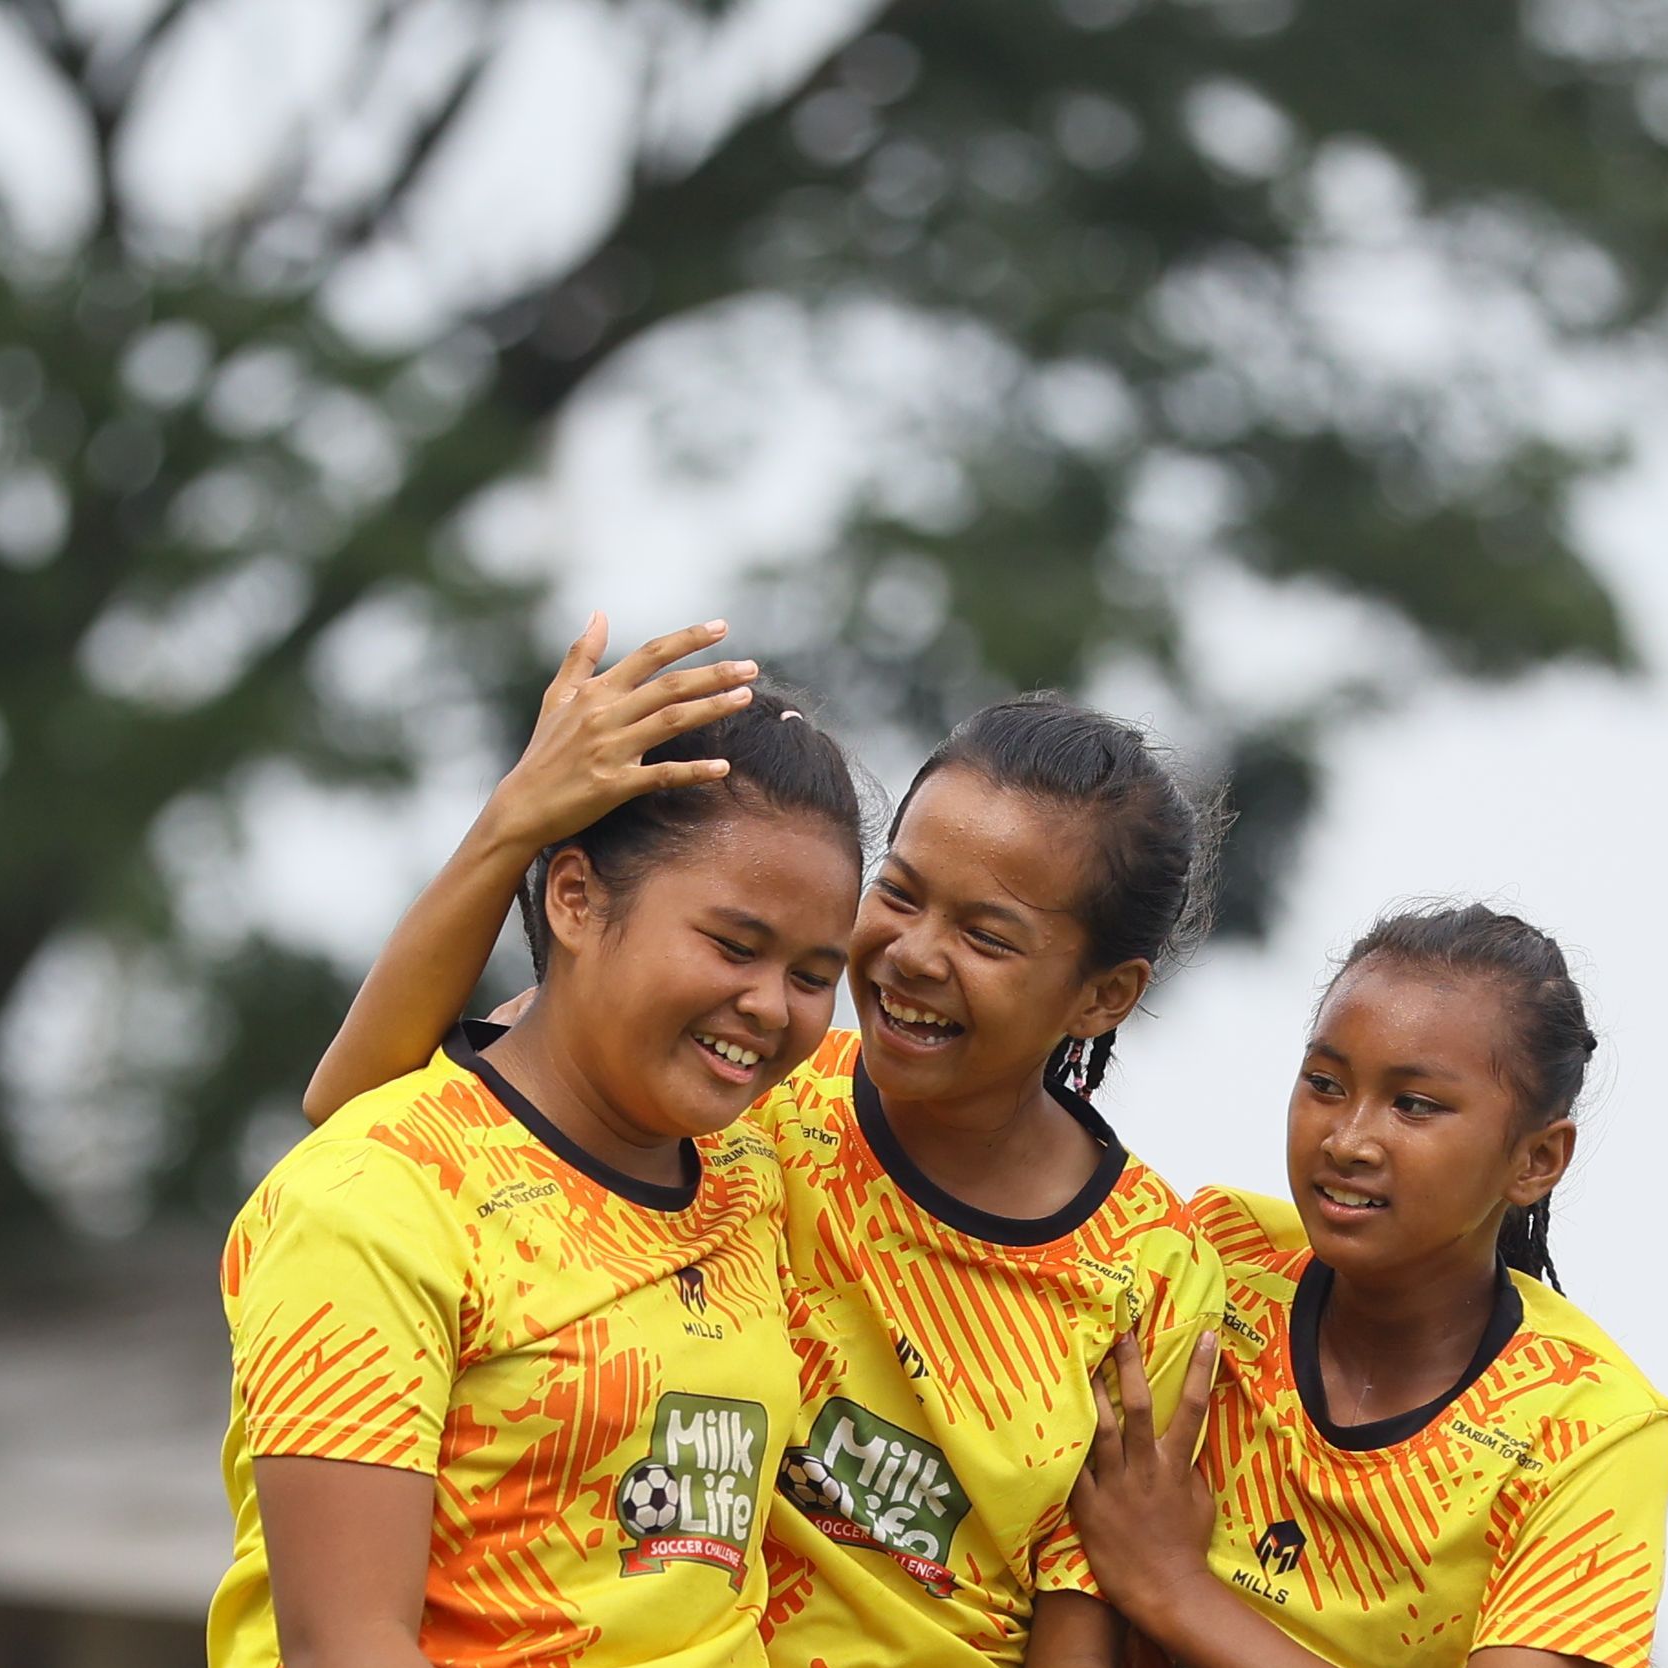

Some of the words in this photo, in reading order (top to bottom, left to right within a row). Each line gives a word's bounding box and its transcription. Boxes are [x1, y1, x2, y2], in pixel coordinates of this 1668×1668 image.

[682, 1321, 723, 1340] MILLS
[666, 1409, 754, 1479] Milk
[823, 1415, 952, 1518] Milk
[678, 1473, 752, 1541] Life
[651, 1540, 703, 1556] SOCCER
[1232, 1568, 1290, 1606] MILLS
